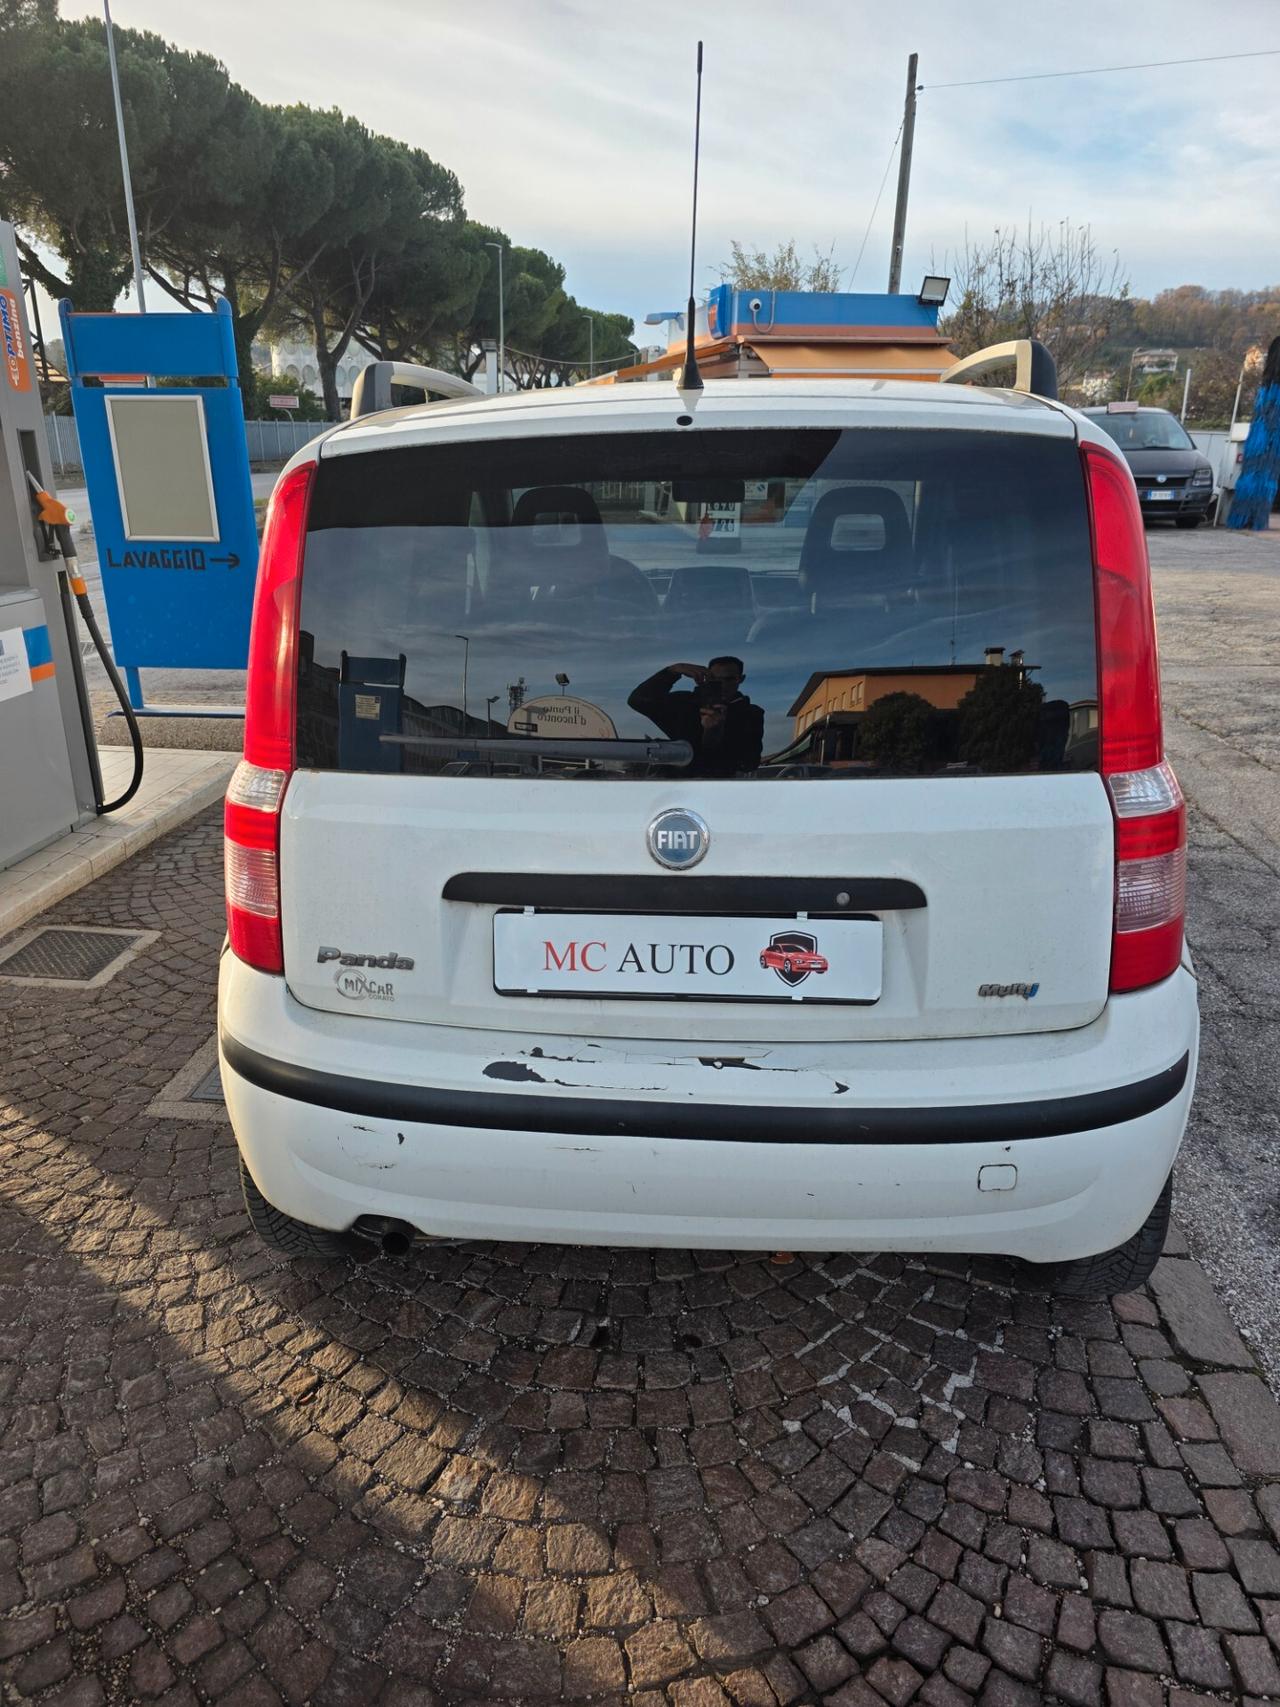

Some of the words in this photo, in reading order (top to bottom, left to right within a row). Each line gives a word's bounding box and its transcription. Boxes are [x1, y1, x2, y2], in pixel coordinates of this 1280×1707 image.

[10, 298, 25, 359] benzina
[106, 547, 206, 571] LAVAGGIO
[657, 830, 698, 849] FIAT
[317, 946, 415, 970] Panda
[542, 941, 607, 972] MC
[616, 942, 735, 975] AUTO
